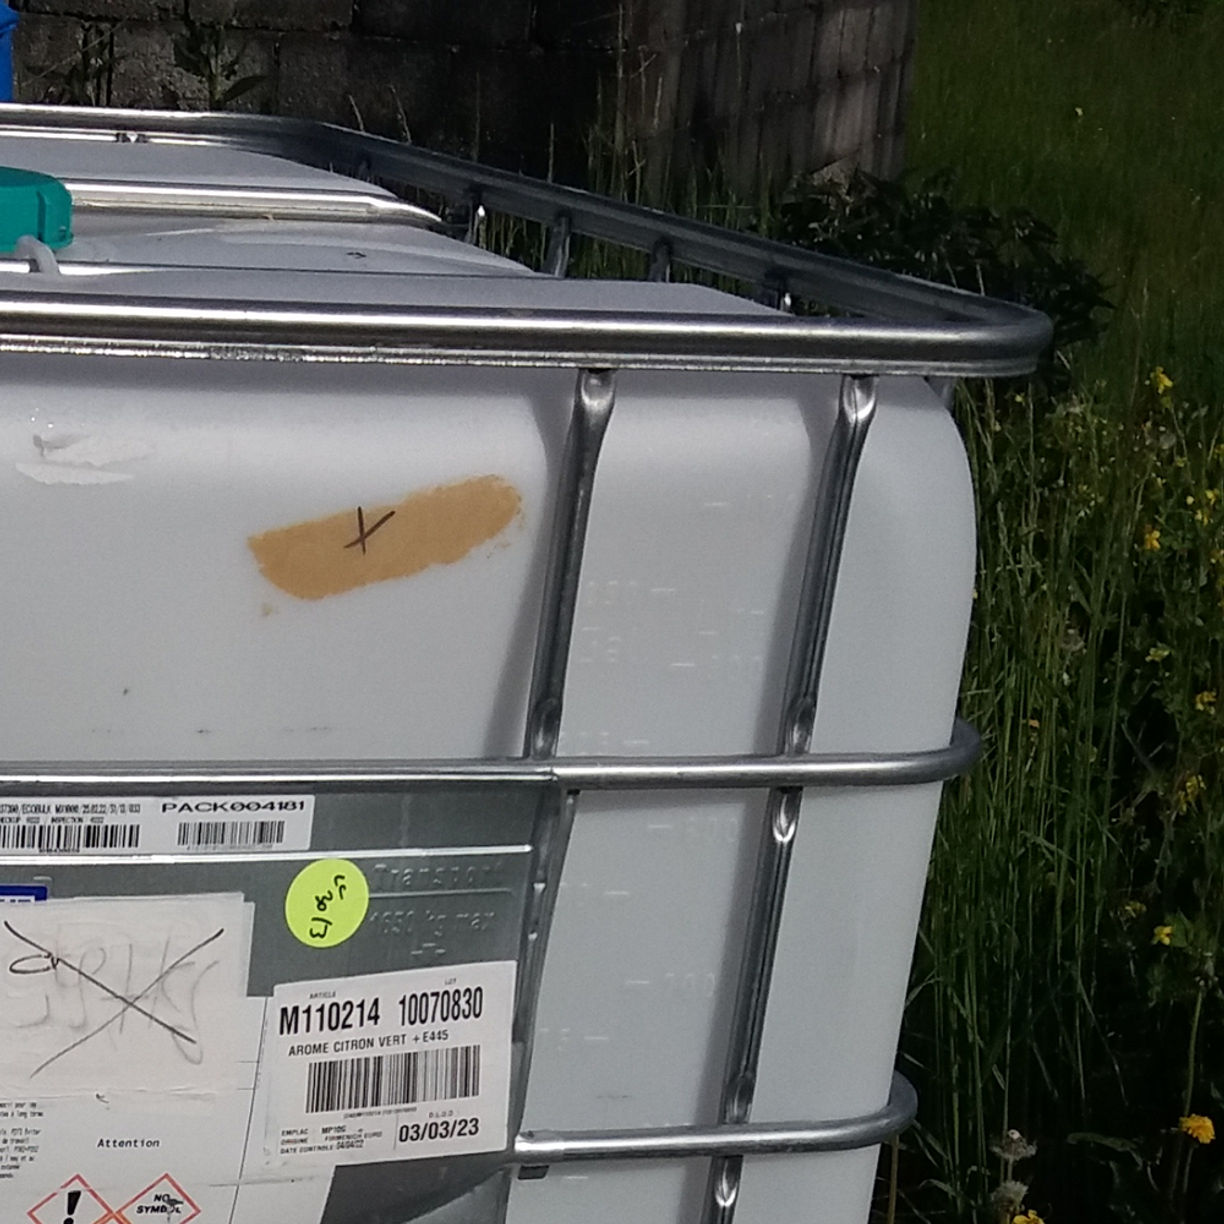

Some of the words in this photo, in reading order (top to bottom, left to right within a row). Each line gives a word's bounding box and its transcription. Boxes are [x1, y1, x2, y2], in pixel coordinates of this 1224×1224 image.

[309, 991, 336, 999] ARTICLE
[279, 997, 380, 1035] M110214
[399, 987, 483, 1026] 10070830
[288, 1043, 329, 1056] AROME
[333, 1037, 374, 1051] CITRON
[378, 1034, 407, 1046] VERT
[399, 1117, 479, 1142] 03/03/23
[97, 1138, 160, 1149] Attention
[153, 1194, 170, 1202] NO
[136, 1205, 181, 1214] SYMBOL
